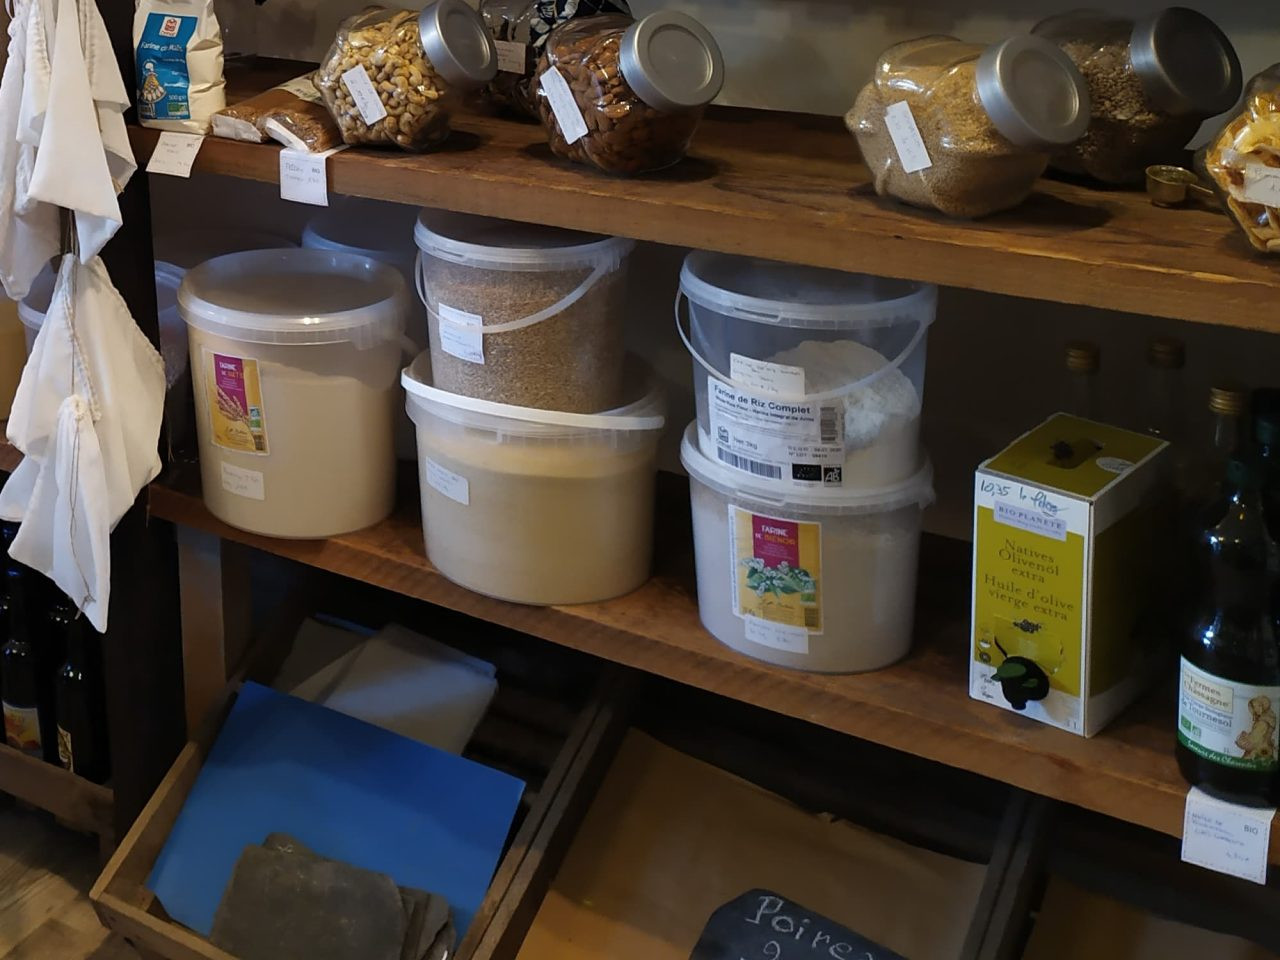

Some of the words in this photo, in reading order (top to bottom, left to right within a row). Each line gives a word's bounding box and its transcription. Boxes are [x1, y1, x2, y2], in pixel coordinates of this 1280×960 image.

[140, 41, 161, 52] Farine
[714, 384, 735, 400] Farine
[737, 396, 749, 404] de
[751, 398, 766, 409] Riz
[768, 401, 811, 416] Complet
[980, 479, 1011, 497] 10,35
[998, 506, 1017, 516] BIO
[1005, 538, 1056, 563] Natives
[998, 548, 1061, 577] Olivenöl
[1011, 566, 1046, 585] extra
[983, 573, 1023, 594] Huile
[1026, 588, 1075, 611] d'olive
[988, 590, 1030, 610] vierge
[1033, 604, 1069, 622] extra
[1243, 824, 1259, 836] BIO
